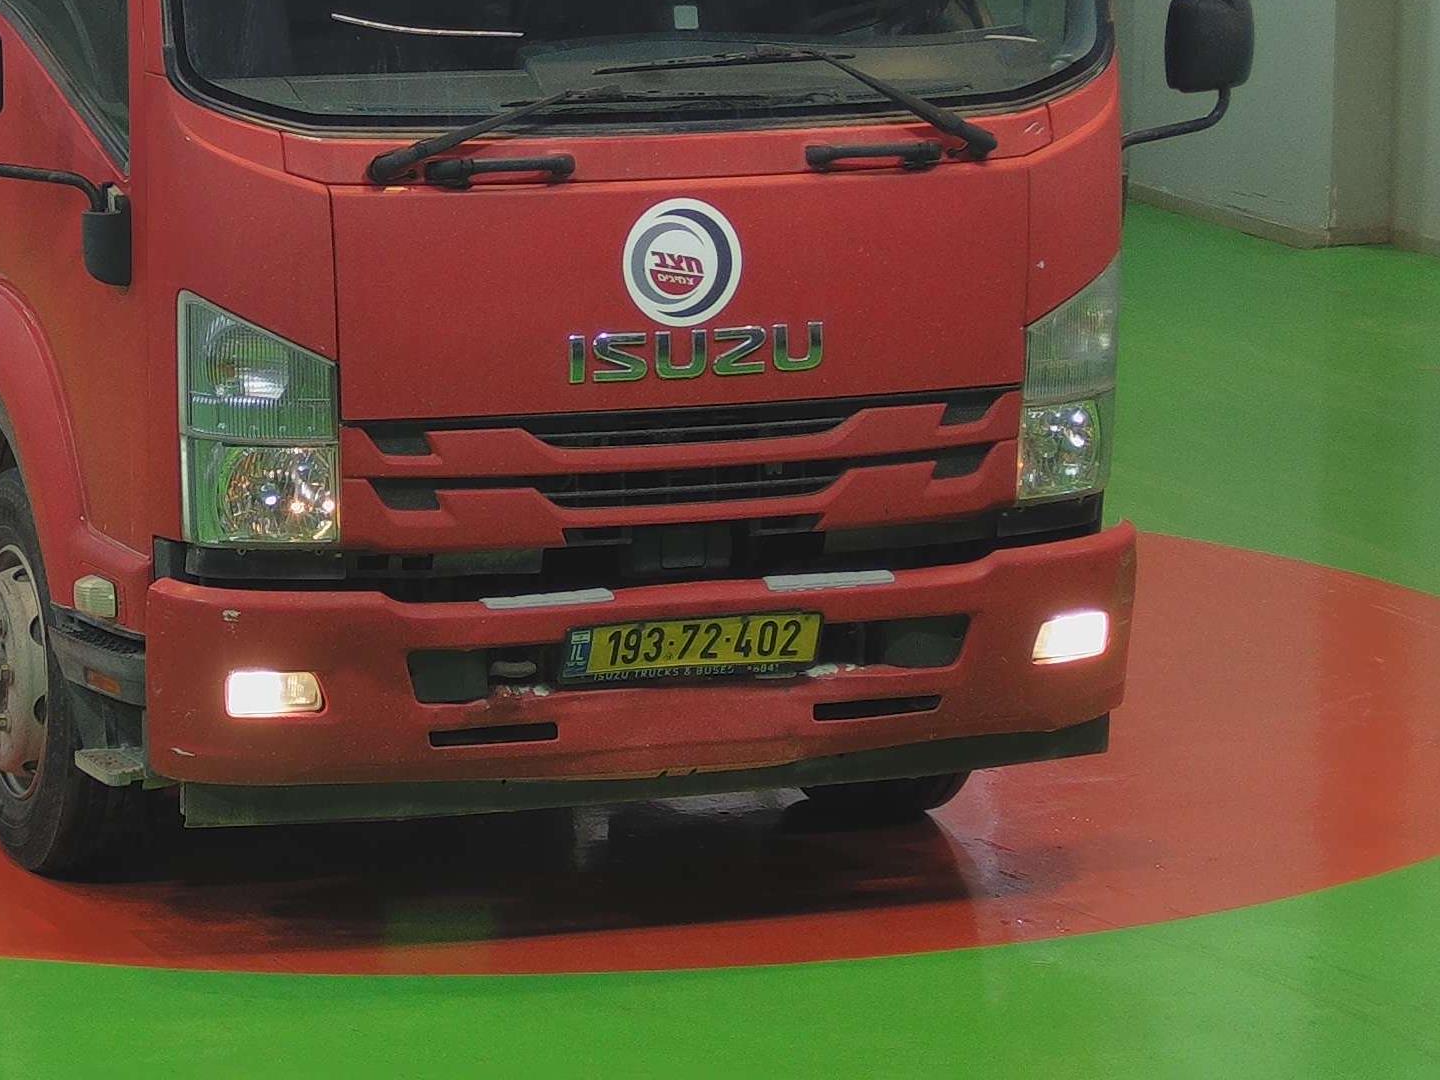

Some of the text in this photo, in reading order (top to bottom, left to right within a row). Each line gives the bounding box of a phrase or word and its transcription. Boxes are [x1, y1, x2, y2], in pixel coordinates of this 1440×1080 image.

[568, 321, 824, 384] ISUZU
[593, 671, 629, 681] ISUZU
[635, 667, 679, 679] TRUCKS
[696, 664, 735, 675] BUSES
